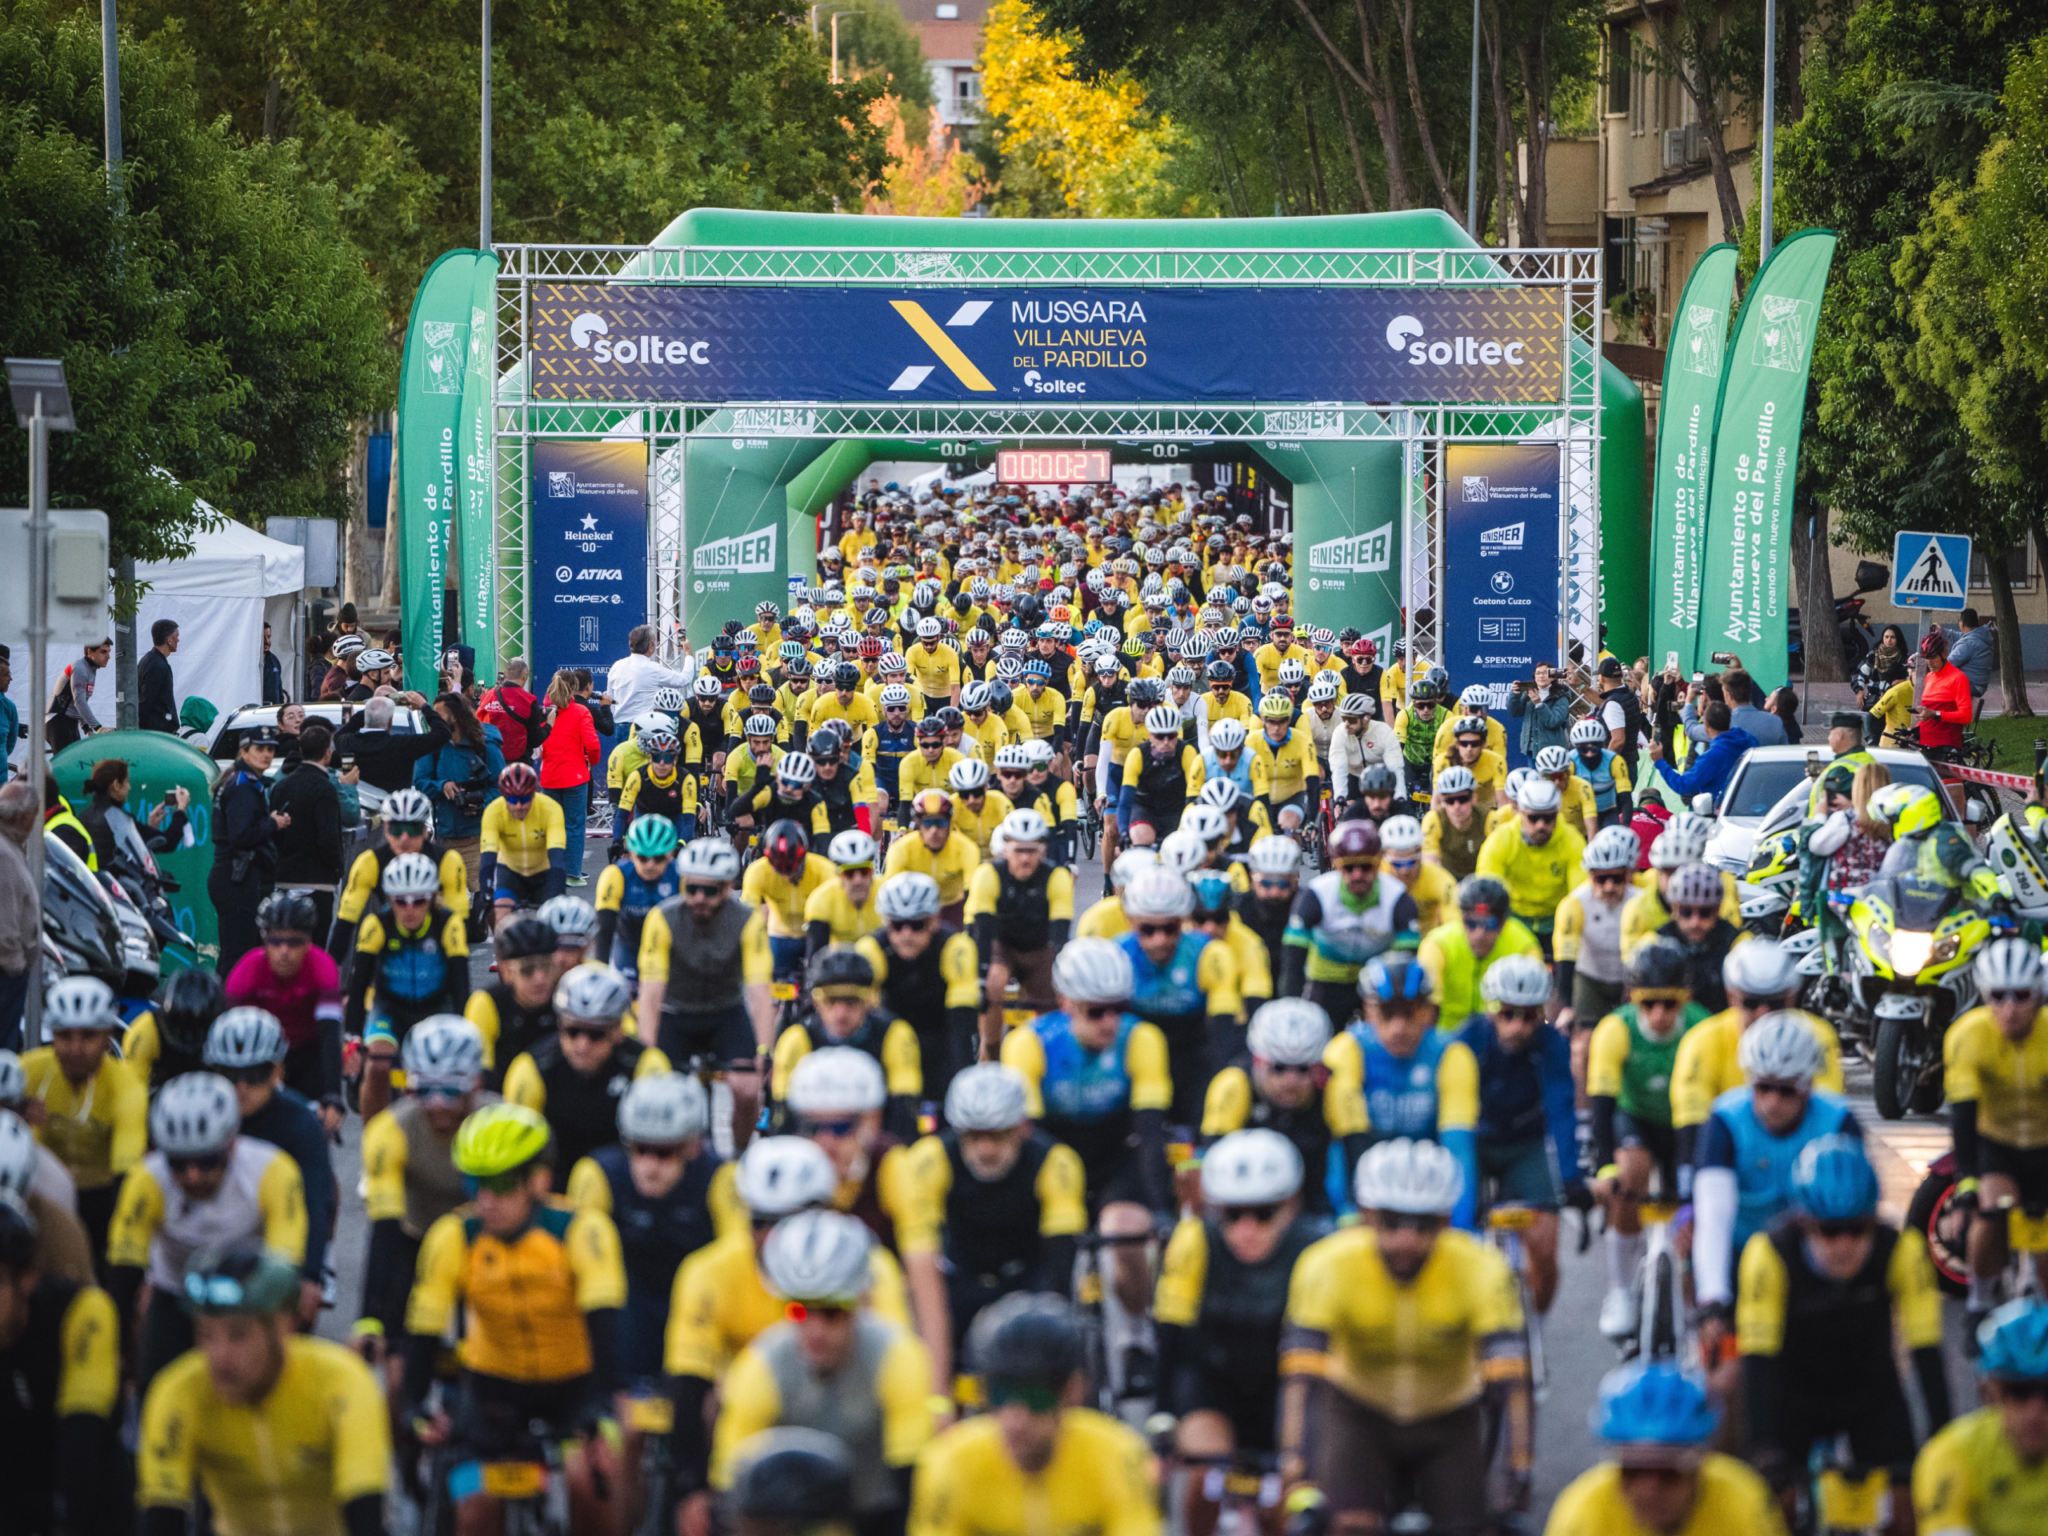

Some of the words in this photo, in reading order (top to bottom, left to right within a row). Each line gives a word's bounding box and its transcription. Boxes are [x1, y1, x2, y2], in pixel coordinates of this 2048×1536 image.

[1012, 300, 1147, 323] MUSSARA
[592, 335, 710, 366] soltec
[1013, 329, 1147, 346] VILLANUEVA
[1407, 336, 1525, 366] soltec
[1013, 356, 1040, 368] DEL
[1044, 350, 1147, 368] PARDILLO
[1012, 386, 1021, 394] by
[1034, 379, 1087, 393] soltec
[940, 442, 967, 457] 0.0
[1152, 444, 1179, 458] 0.0
[1688, 404, 1701, 481] Pardillo
[1751, 401, 1776, 484] Pardillo
[440, 428, 453, 510] Pardillo
[1002, 452, 1106, 482] 00:00:27
[1674, 453, 1686, 479] de
[1698, 446, 1709, 501] municipio
[1734, 454, 1750, 482] de
[1773, 446, 1787, 505] municipio
[424, 483, 437, 511] de
[1687, 488, 1696, 519] del
[1749, 490, 1765, 526] del
[564, 531, 613, 540] Heineken
[1482, 527, 1520, 541] FINISHER
[1769, 509, 1780, 545] nuevo
[696, 535, 770, 567] FINISHER
[1311, 534, 1386, 565] FINISHER
[1669, 487, 1687, 629] Ayuntamiento
[1768, 549, 1777, 564] un
[576, 569, 623, 580] ATIKA
[1686, 527, 1699, 629] Villanueva
[1724, 490, 1747, 643] Ayuntamiento
[554, 595, 610, 603] COMPEX
[1473, 597, 1506, 605] Caetano
[1507, 597, 1532, 605] Cuzco
[1747, 532, 1762, 644] Villanueva
[1766, 567, 1777, 617] Creando
[580, 642, 599, 652] SKIN
[1484, 656, 1532, 664] SPEKTRUM
